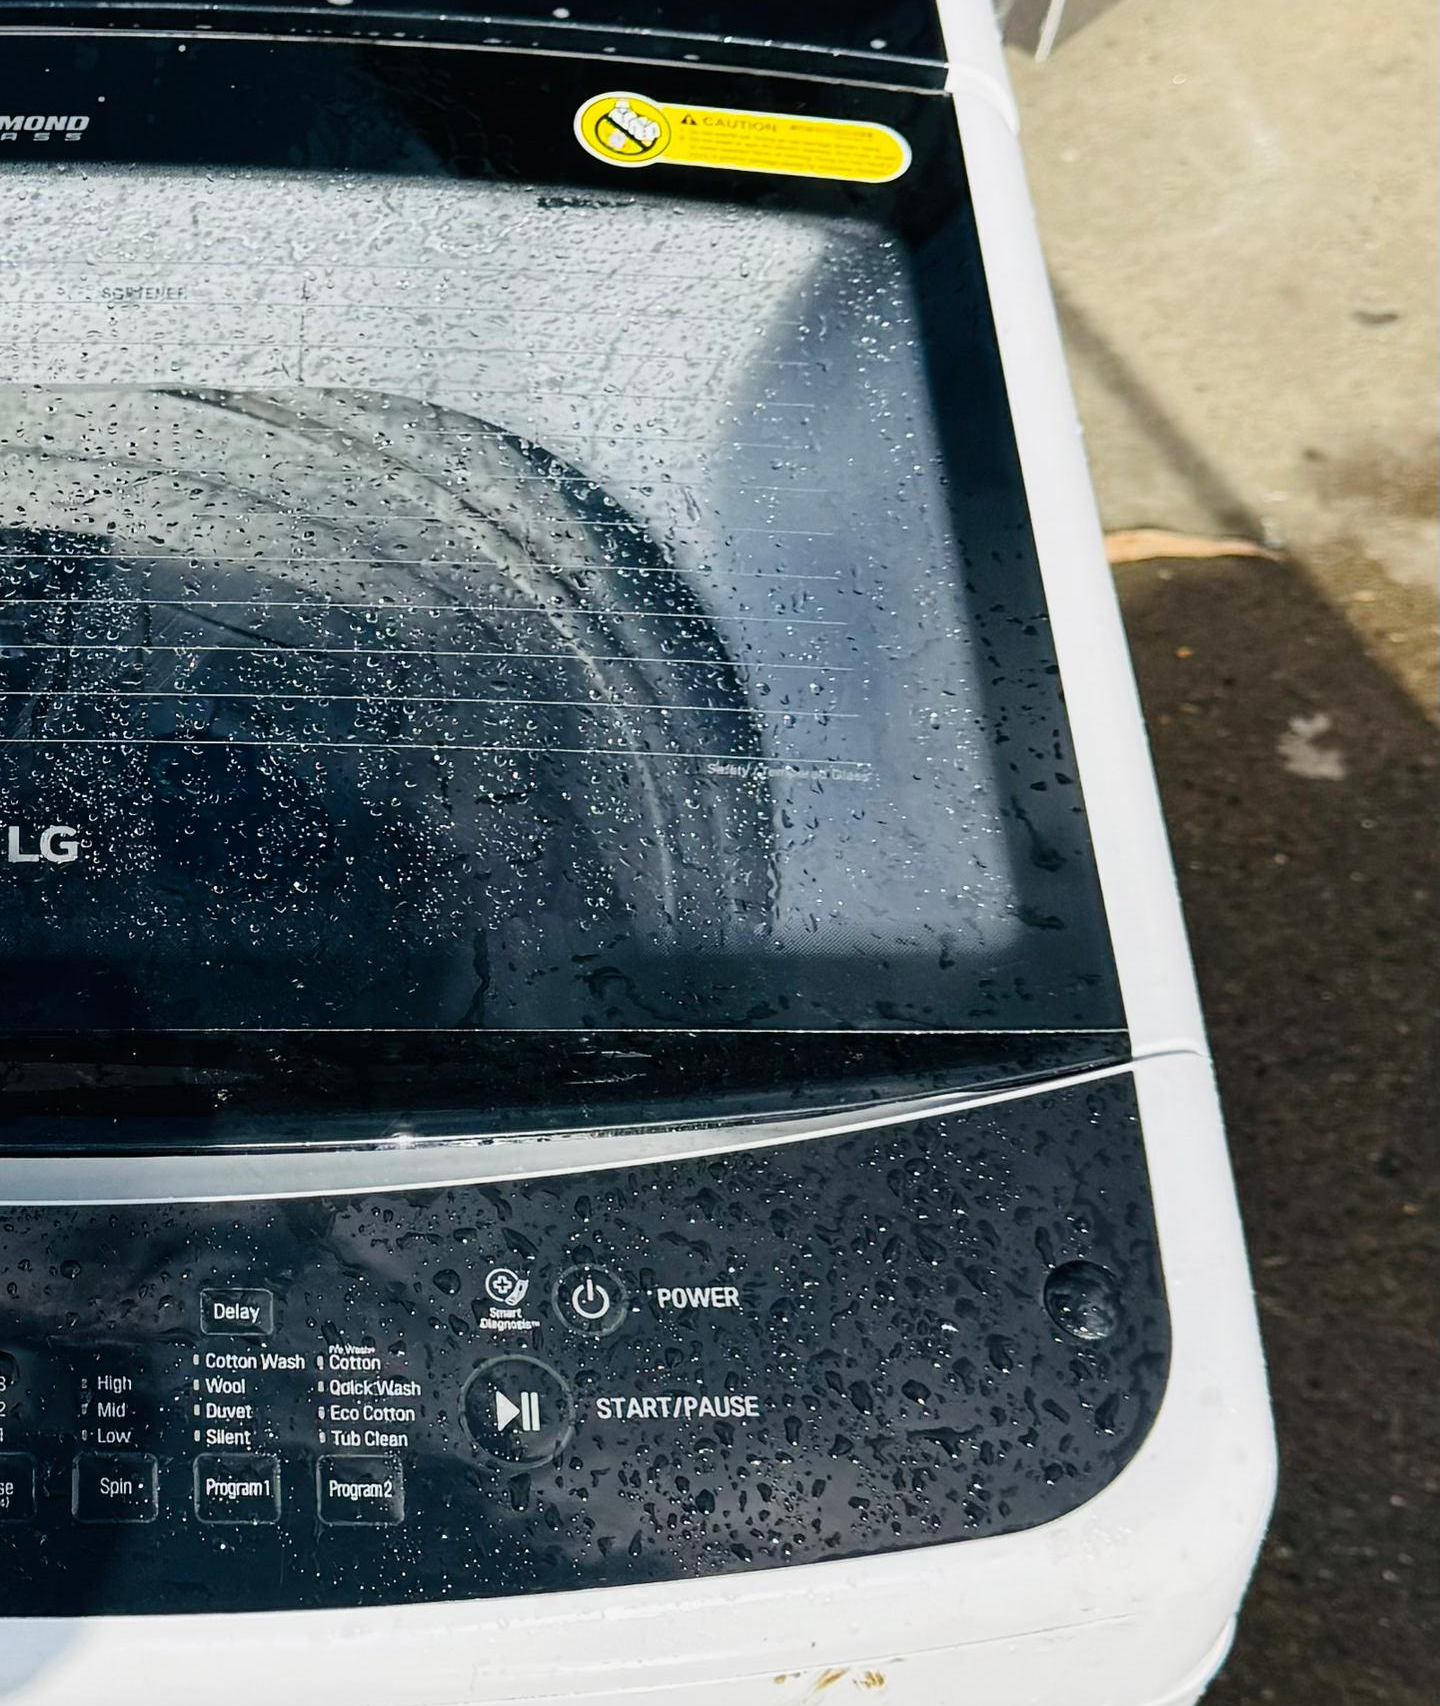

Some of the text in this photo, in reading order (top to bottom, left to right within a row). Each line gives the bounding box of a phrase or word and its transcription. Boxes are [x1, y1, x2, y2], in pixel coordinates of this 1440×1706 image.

[702, 115, 777, 133] CAUTION
[9, 825, 80, 863] LG
[657, 1286, 740, 1309] POWER
[213, 1303, 260, 1323] Delay
[489, 1307, 522, 1319] Smart
[205, 1353, 306, 1370] Cotton Wash
[329, 1354, 381, 1370] Cotton
[97, 1376, 132, 1393] High
[205, 1378, 246, 1394] Wool
[329, 1379, 422, 1397] Quick Wash
[97, 1402, 126, 1418] Mid
[205, 1404, 252, 1420] Duvet
[330, 1405, 415, 1422] Eco Cotton
[596, 1395, 760, 1419] START/PAUSE
[97, 1429, 131, 1444] Low
[205, 1429, 251, 1445] Silent
[330, 1430, 408, 1448] Tub Clean
[100, 1477, 132, 1497] Spin
